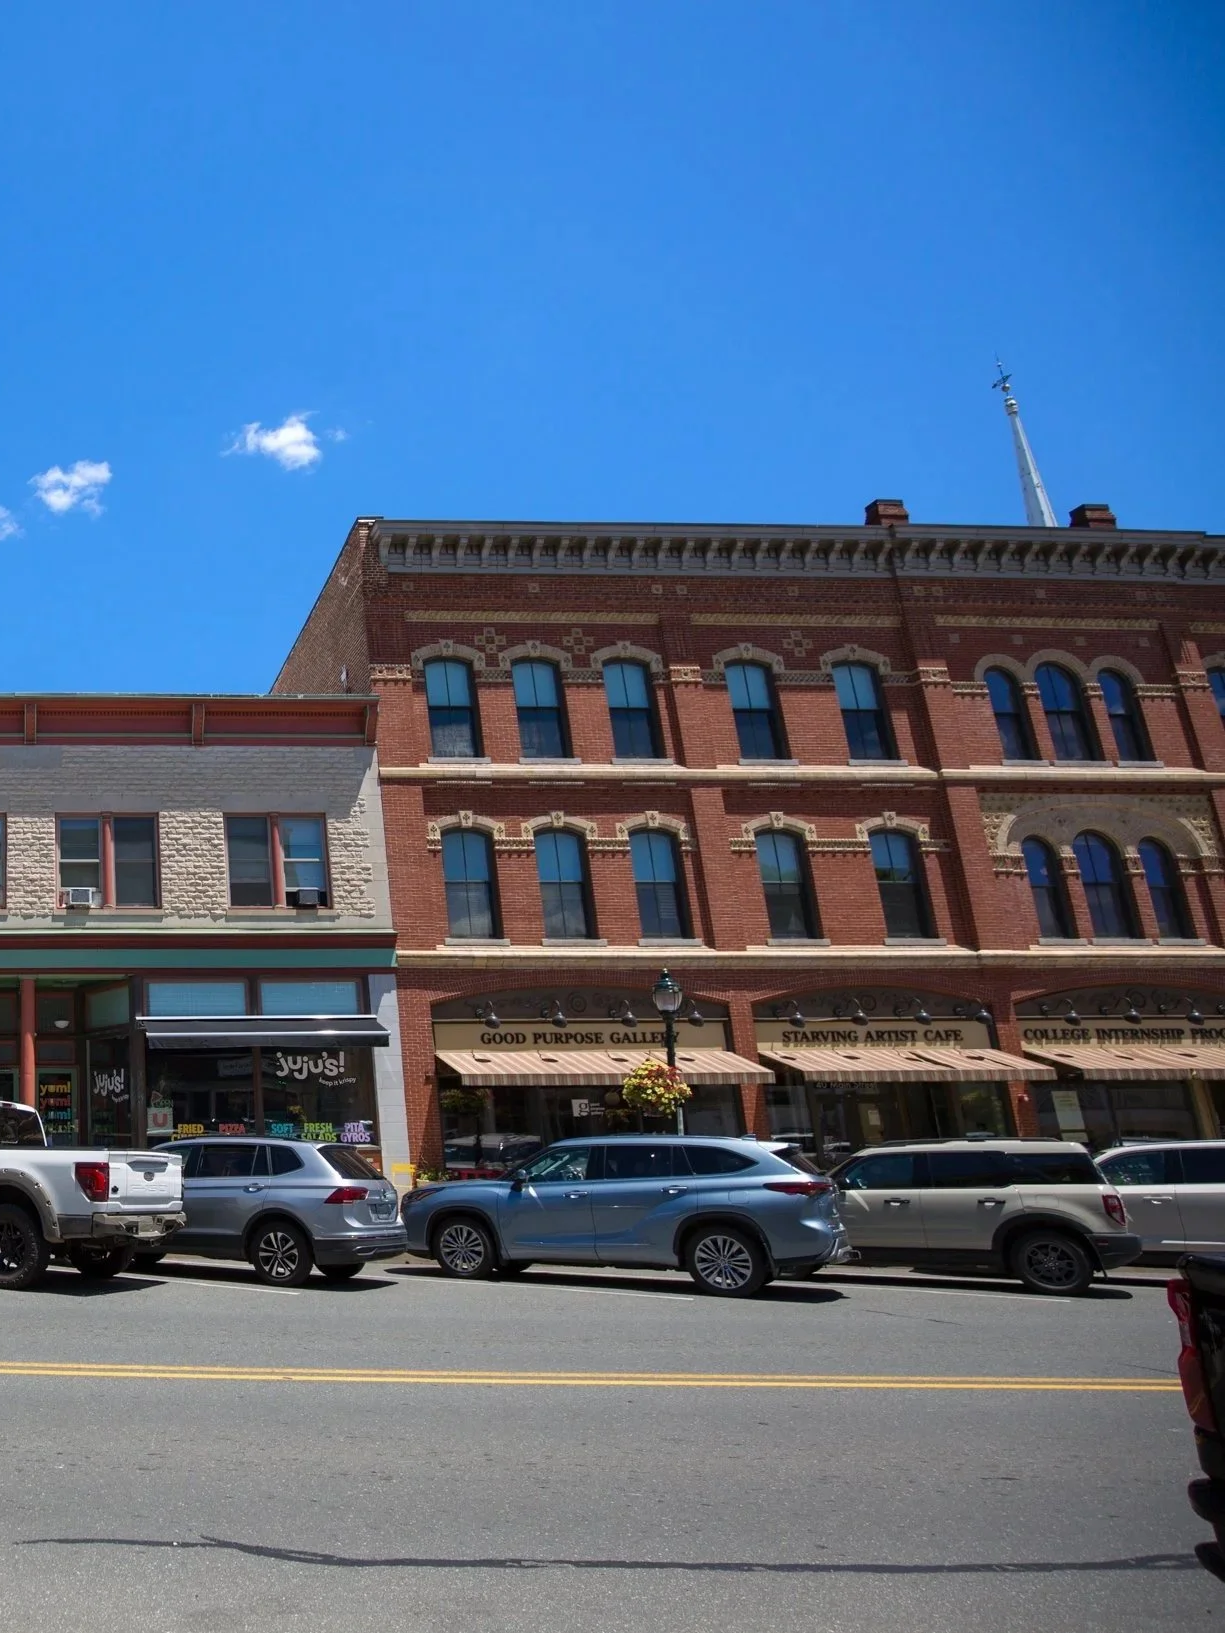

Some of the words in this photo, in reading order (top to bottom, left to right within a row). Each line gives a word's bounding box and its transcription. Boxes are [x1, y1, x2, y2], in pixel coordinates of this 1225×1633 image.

[480, 1031, 527, 1044] GOOD
[532, 1031, 605, 1044] PURPOSE
[782, 1030, 859, 1043] STARVING
[864, 1030, 918, 1042] ARTIST
[923, 1029, 964, 1042] CAFE
[1023, 1028, 1091, 1041] COLLEGE
[1096, 1028, 1185, 1041] INTERNSHIP
[276, 1051, 345, 1080] juju's!
[93, 1068, 125, 1097] juju's!
[318, 1076, 334, 1087] keep
[39, 1081, 72, 1096] yum!
[177, 1123, 205, 1134] FRIED
[218, 1123, 246, 1134] PIZZA
[271, 1123, 294, 1134] SOFT
[303, 1122, 333, 1133] FRESH
[344, 1122, 366, 1133] PITA
[301, 1133, 337, 1142] SALADS
[340, 1132, 371, 1143] GYROS
